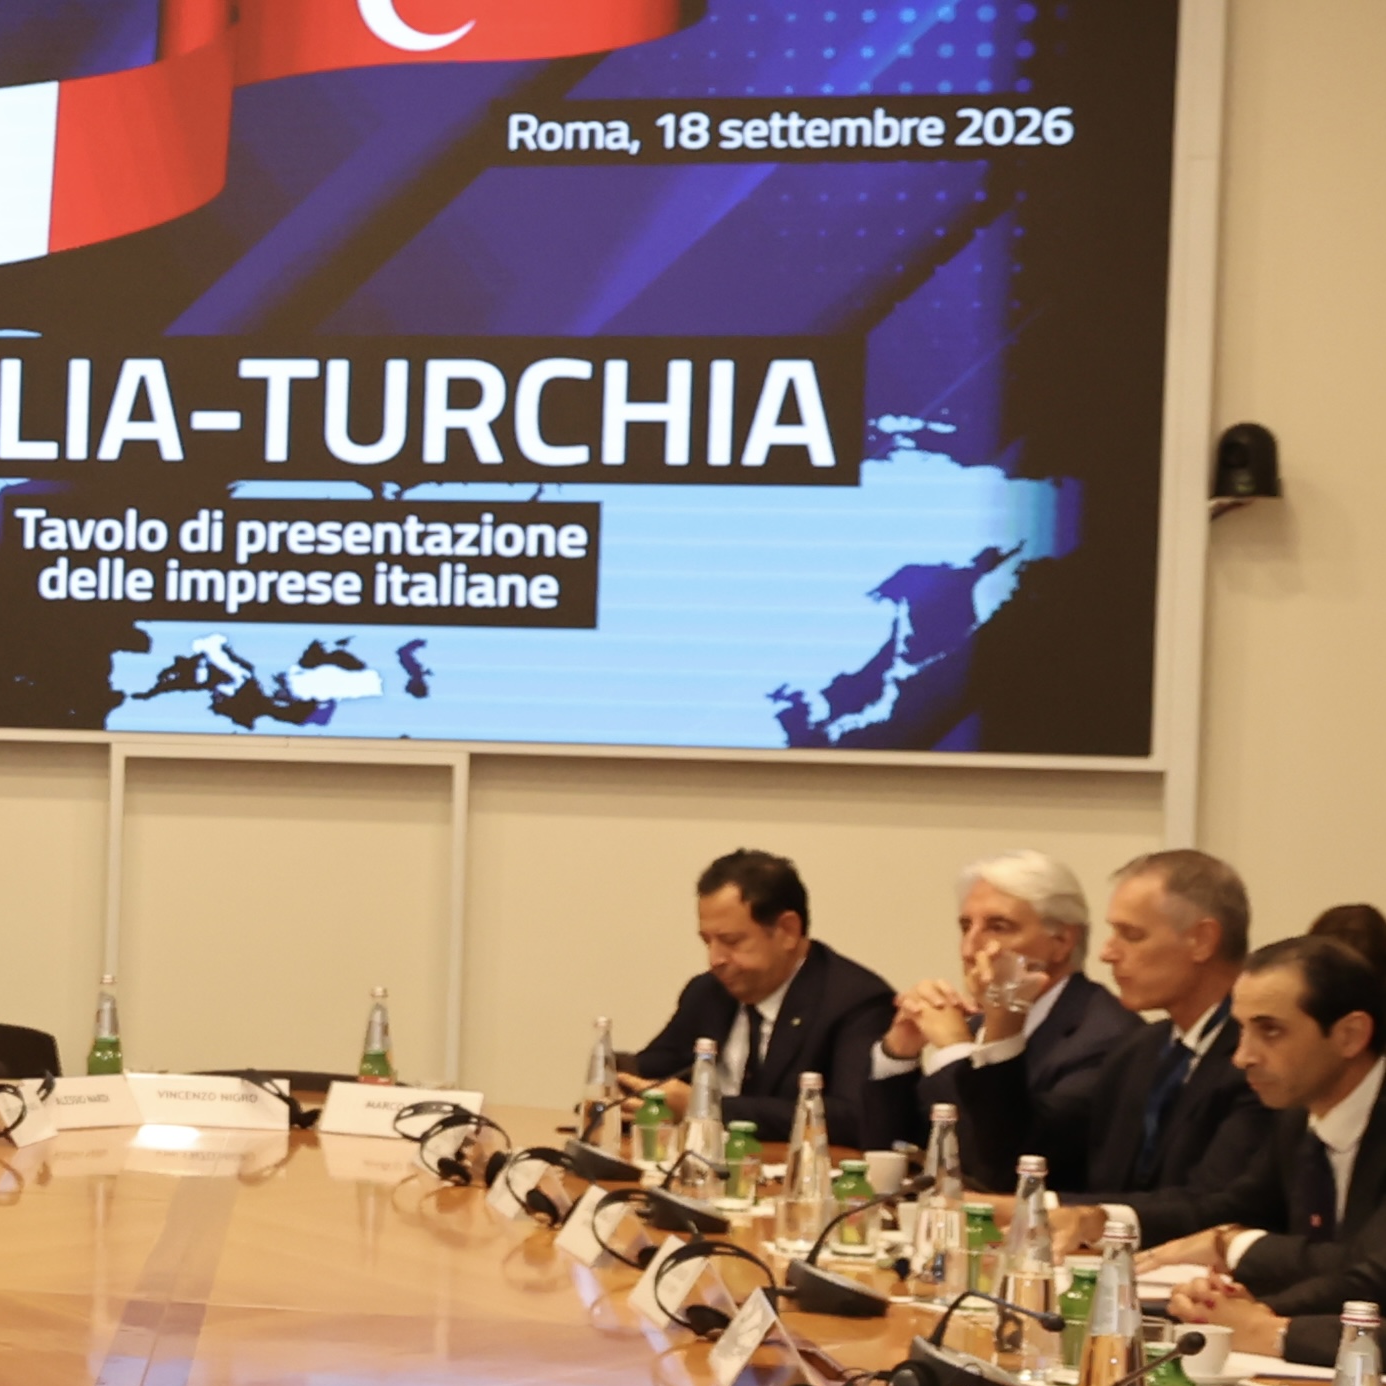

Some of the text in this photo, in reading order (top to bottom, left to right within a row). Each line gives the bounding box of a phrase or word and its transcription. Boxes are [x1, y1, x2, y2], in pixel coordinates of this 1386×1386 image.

[507, 107, 1074, 155] Roma, 18 settembre 2026
[14, 508, 589, 565] Tavolo di presentazione
[38, 556, 560, 614] delle imprese italiane
[157, 1089, 259, 1105] VINCENZO NIGRO
[365, 1100, 405, 1112] MARCO
